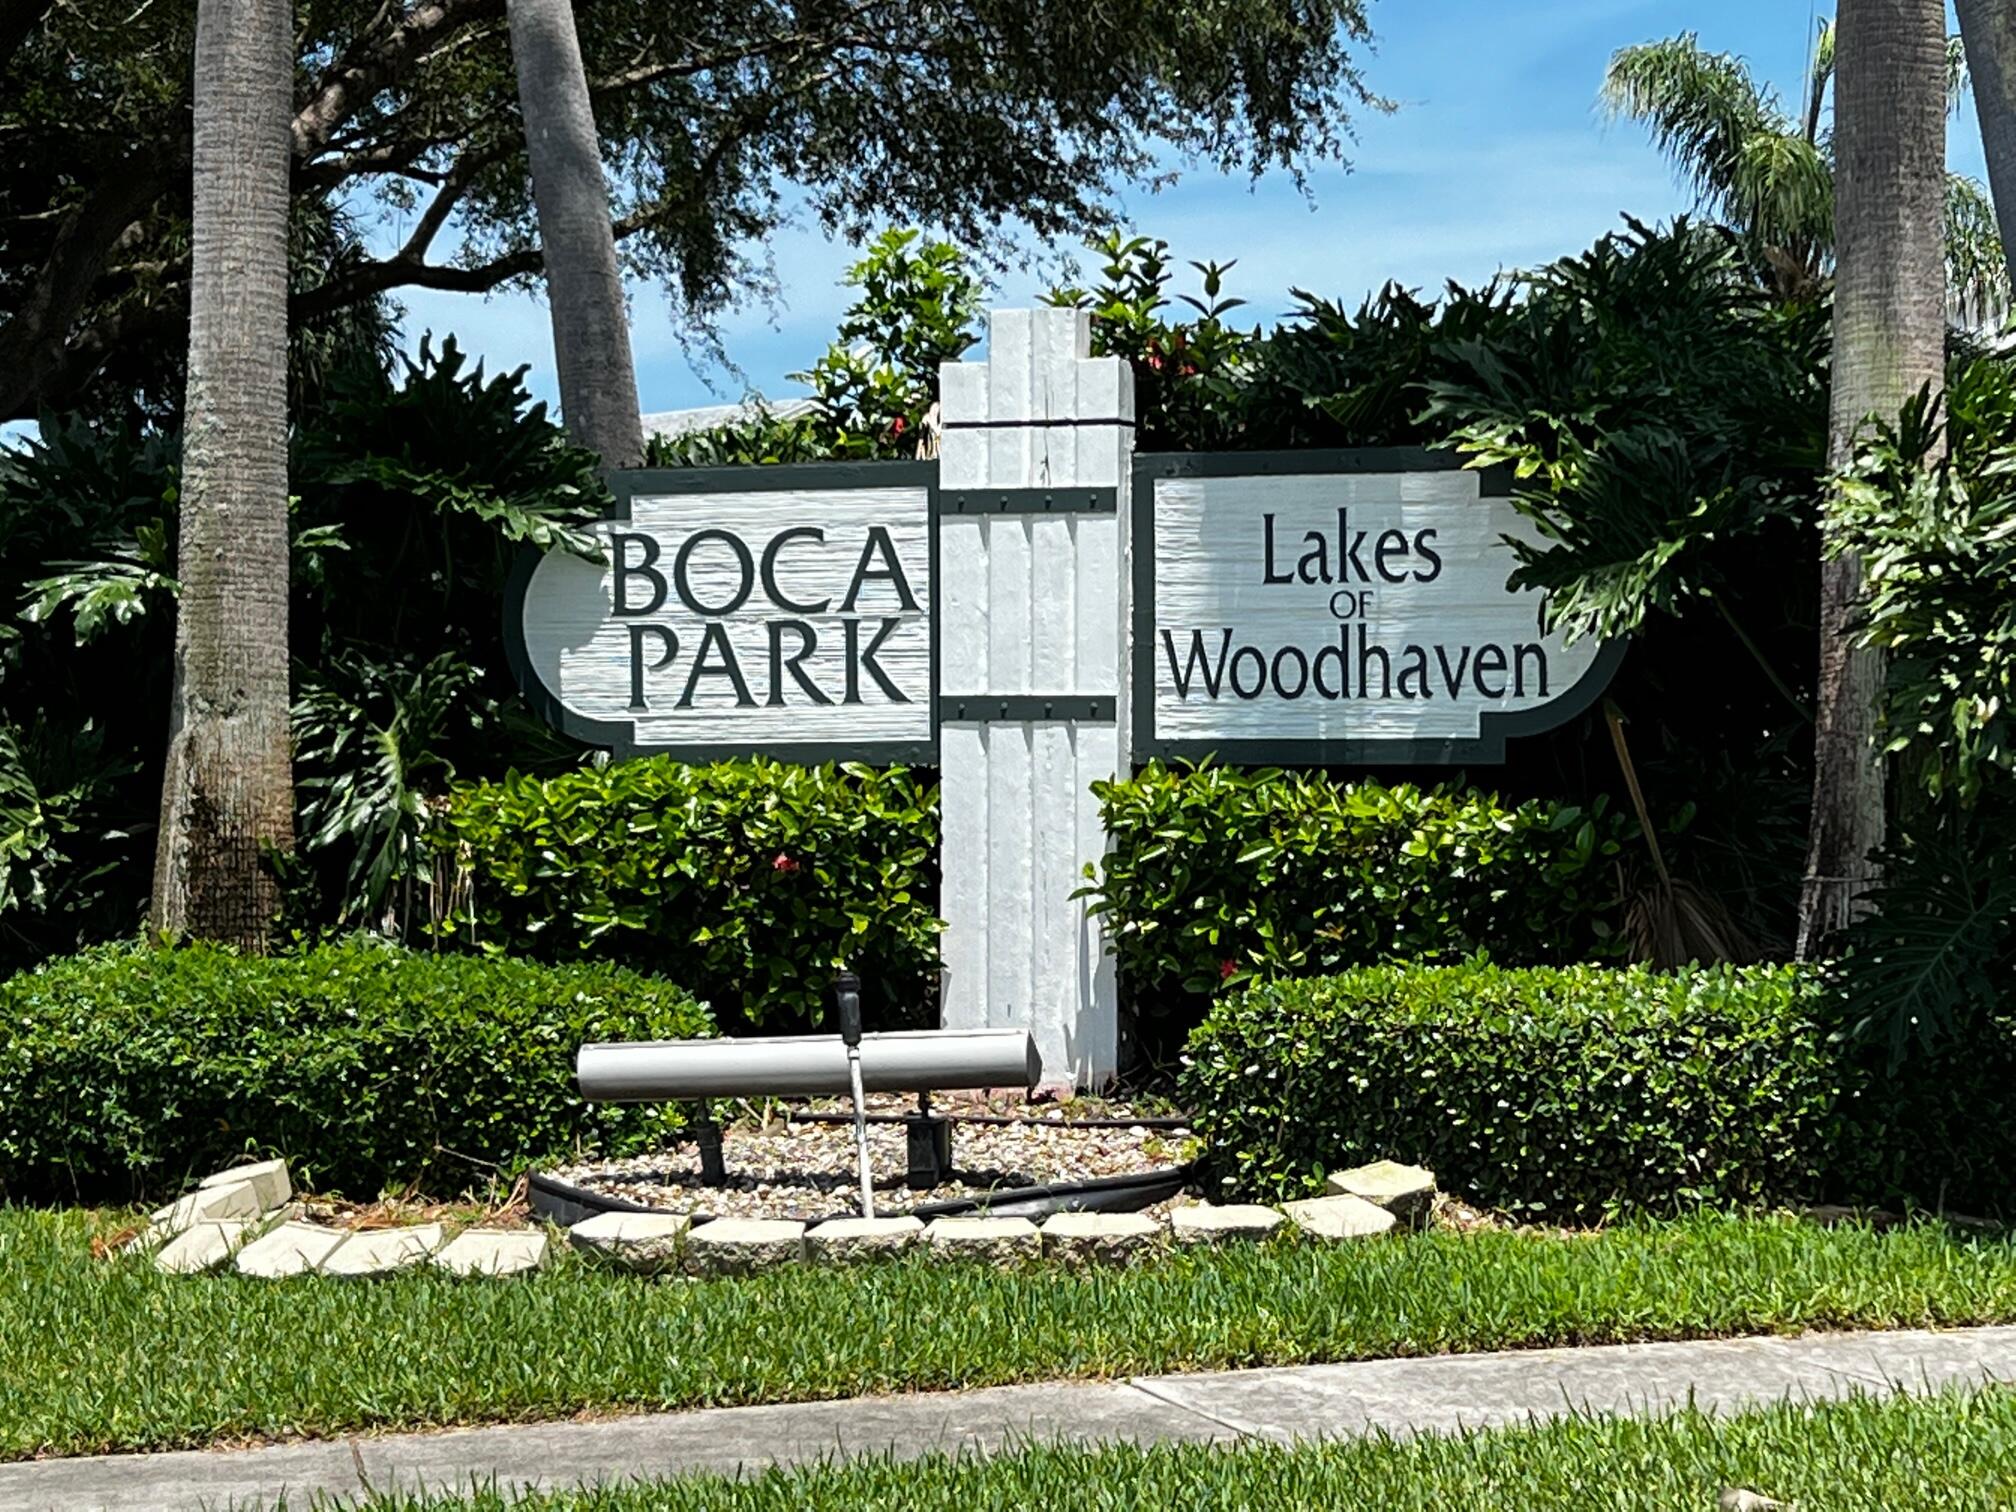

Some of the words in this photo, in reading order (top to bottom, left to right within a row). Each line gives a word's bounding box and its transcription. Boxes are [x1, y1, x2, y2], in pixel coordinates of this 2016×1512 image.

[609, 526, 923, 616] BOCA
[1263, 507, 1442, 585] Lakes
[1329, 590, 1374, 619] OF
[627, 617, 912, 709] PARK
[1160, 623, 1550, 701] Woodhaven
